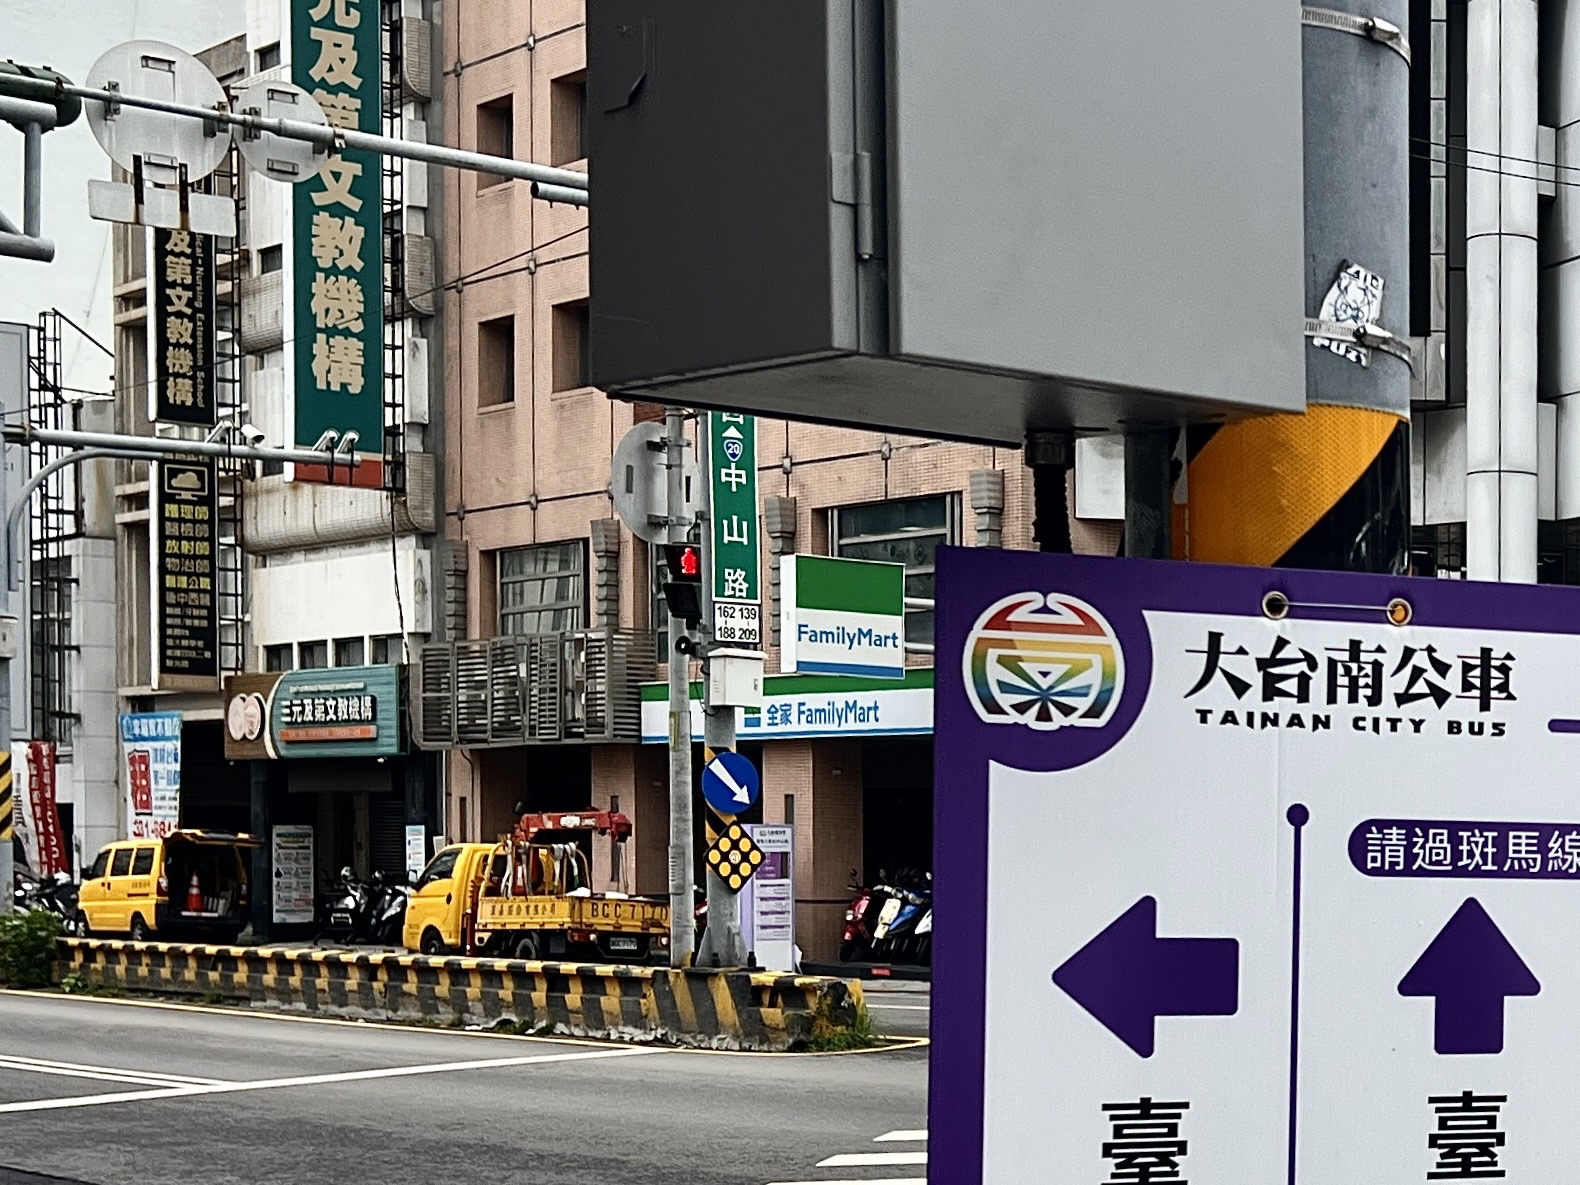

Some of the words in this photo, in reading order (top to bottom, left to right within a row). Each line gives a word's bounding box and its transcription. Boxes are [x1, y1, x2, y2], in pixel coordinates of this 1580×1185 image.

[196, 313, 205, 366] Extension
[197, 371, 206, 408] School
[727, 443, 740, 455] 20
[720, 462, 750, 598] 中山路
[717, 606, 736, 619] 162
[738, 607, 757, 620] 139
[717, 626, 736, 640] 188
[738, 628, 757, 641] 209
[797, 624, 899, 650] FamilyMart
[1183, 630, 1518, 712] 大台南公車
[281, 695, 373, 723] 三元及第文教機構
[766, 703, 793, 727] 全家
[797, 700, 880, 727] FamilyMart
[1195, 708, 1333, 733] TAINAN
[1351, 715, 1428, 736] CITY
[1446, 718, 1508, 738] BUS
[591, 902, 622, 918] BGC
